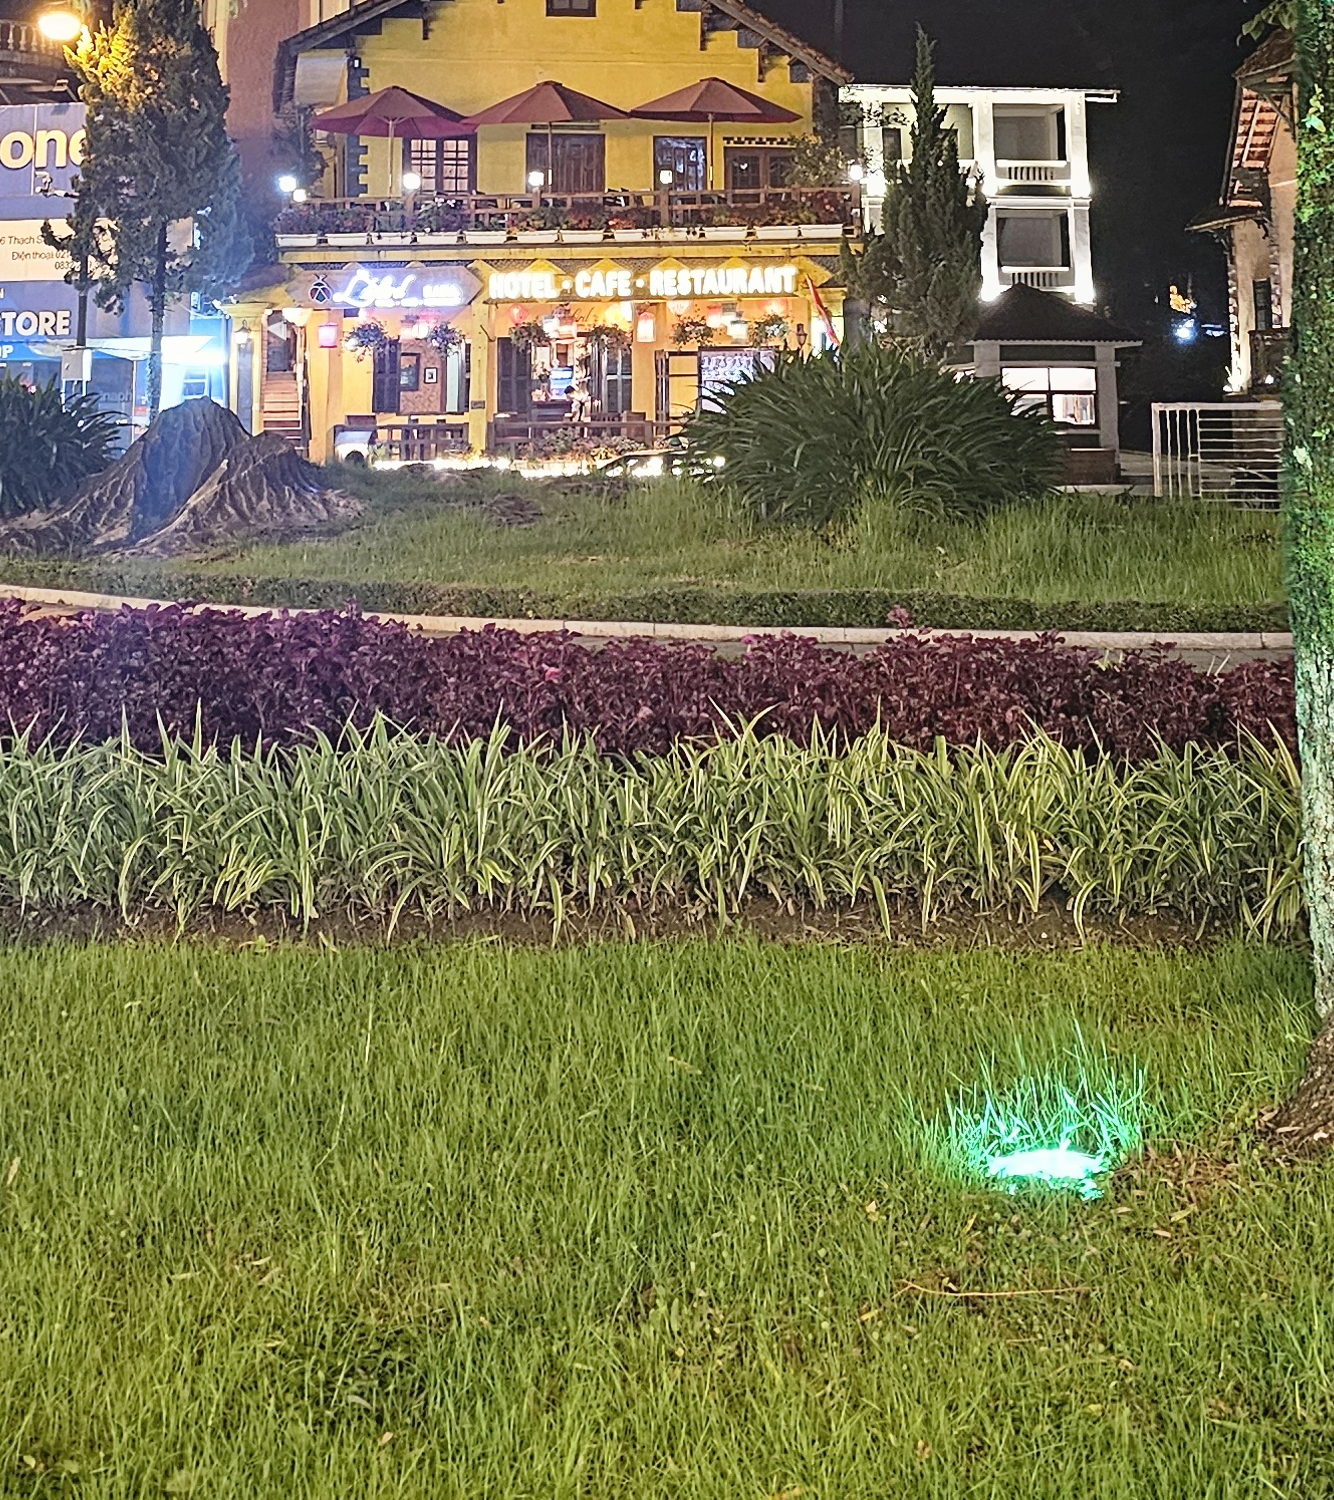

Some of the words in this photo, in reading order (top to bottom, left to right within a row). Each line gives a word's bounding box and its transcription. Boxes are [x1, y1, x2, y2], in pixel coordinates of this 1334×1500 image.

[488, 270, 558, 299] HOTEL
[575, 269, 634, 297] CAFE
[648, 266, 798, 297] RESTAURANT
